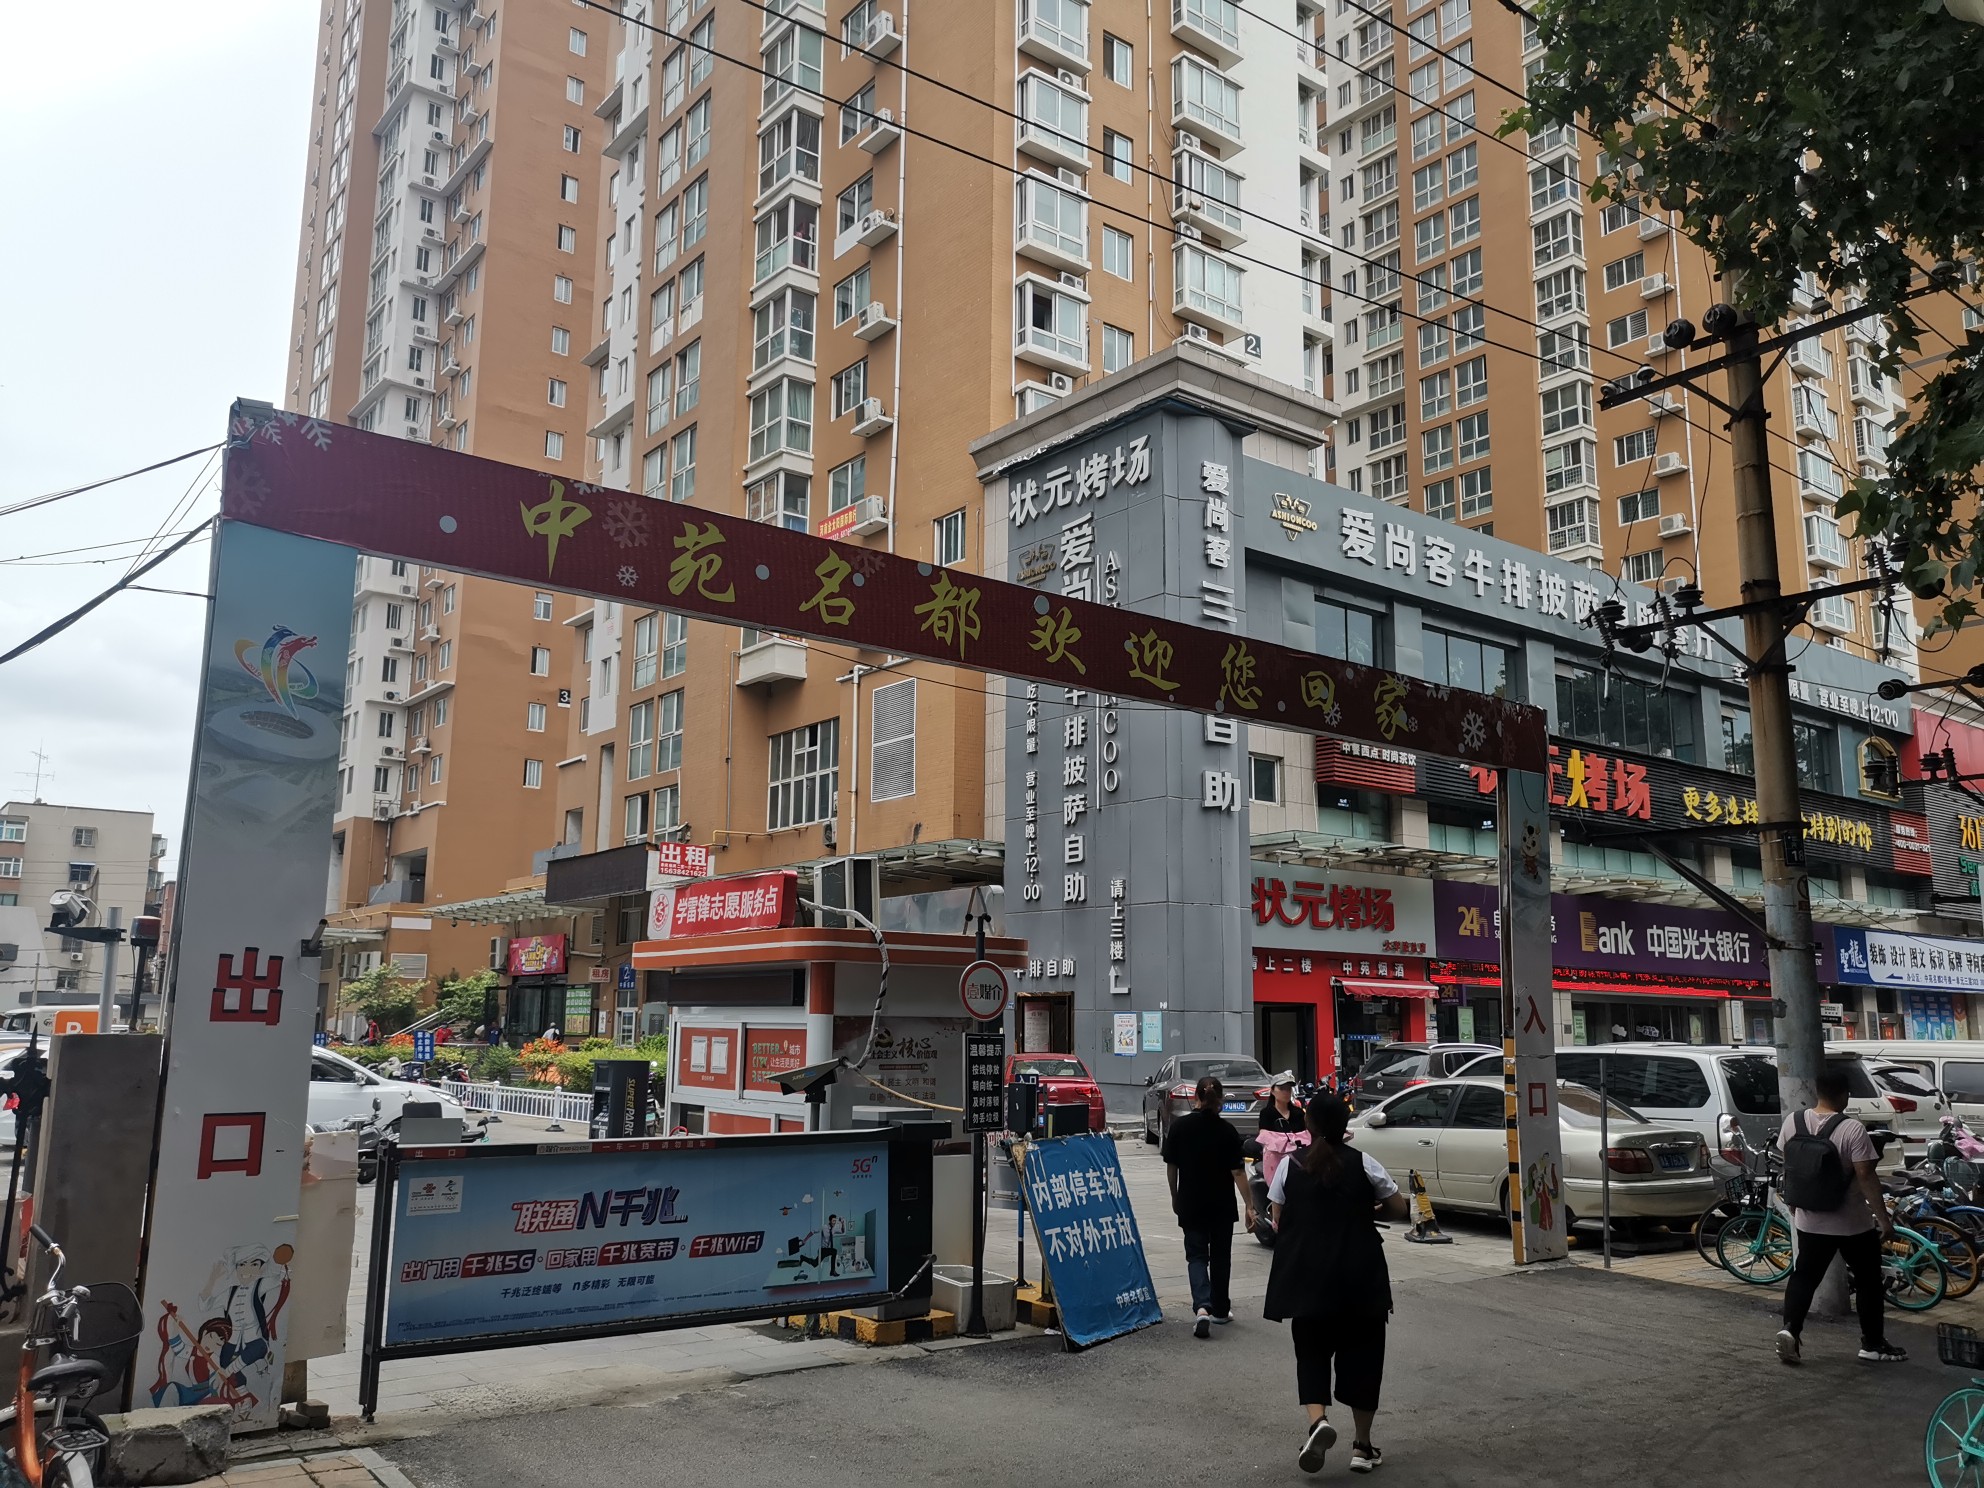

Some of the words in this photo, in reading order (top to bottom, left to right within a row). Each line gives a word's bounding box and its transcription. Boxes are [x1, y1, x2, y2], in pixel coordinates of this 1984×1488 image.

[1246, 335, 1257, 354] 2
[1008, 434, 1153, 528] 状元烤场
[1104, 550, 1120, 608] AS
[560, 690, 569, 702] 3
[1342, 742, 1379, 759] 中餐西点
[1382, 749, 1417, 766] 时尚茶饮
[1802, 811, 1873, 852] 特别的你
[661, 844, 706, 866] 出租
[675, 884, 779, 926] 学雷锋志愿服务点
[1251, 876, 1396, 932] 状元烤场
[1110, 879, 1125, 961] 请上三楼
[1580, 911, 1635, 956] Bank
[1646, 924, 1751, 964] 中国光大银行
[1869, 943, 1887, 967] 装饰
[1889, 945, 1906, 968] 设计
[1909, 946, 1926, 969] 图文
[592, 968, 610, 979] 租房
[1343, 959, 1406, 978] 中苑烟酒
[967, 983, 1003, 1001] 壹媒介
[789, 1043, 801, 1055] 城市
[916, 1049, 938, 1060] 价值观
[969, 1044, 1002, 1057] 温馨提示
[1523, 994, 1548, 1117] 入口
[972, 1063, 1000, 1075] 按线停放
[972, 1080, 1000, 1092] 朝向统一
[972, 1112, 1000, 1124] 勿丢垃圾
[1031, 1166, 1123, 1213] 内部停车场
[693, 1234, 761, 1256] 千兆WiFi
[1044, 1211, 1137, 1263] 不对外开放
[617, 1274, 656, 1288] 无限可能
